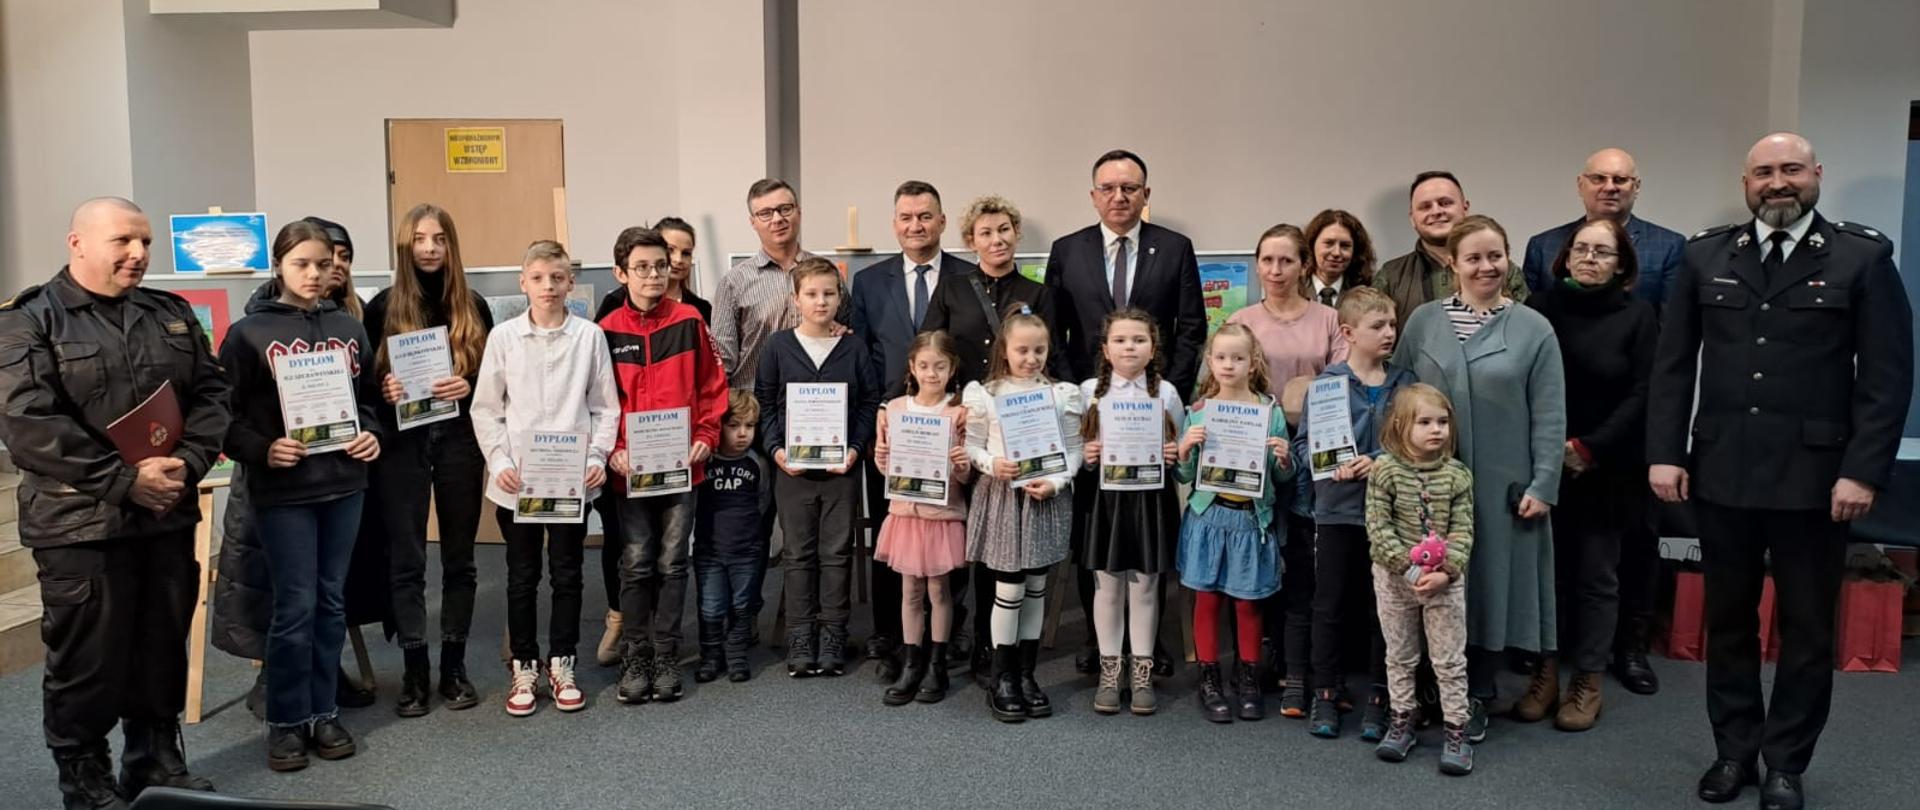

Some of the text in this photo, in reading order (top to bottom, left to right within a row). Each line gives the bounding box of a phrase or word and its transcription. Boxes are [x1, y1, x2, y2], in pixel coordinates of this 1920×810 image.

[399, 332, 437, 347] DYPLOM
[288, 354, 335, 368] DYPLOM
[799, 387, 836, 395] DYPLOM
[1006, 392, 1044, 406] DYPLOM
[1112, 401, 1153, 411] DYPLOM
[1217, 404, 1260, 416] DYPLOM
[638, 412, 679, 424] DYPLOM
[902, 415, 941, 427] DYPLOM
[534, 434, 577, 444] DYPLOM
[705, 466, 725, 480] EW
[714, 478, 742, 490] GAP
